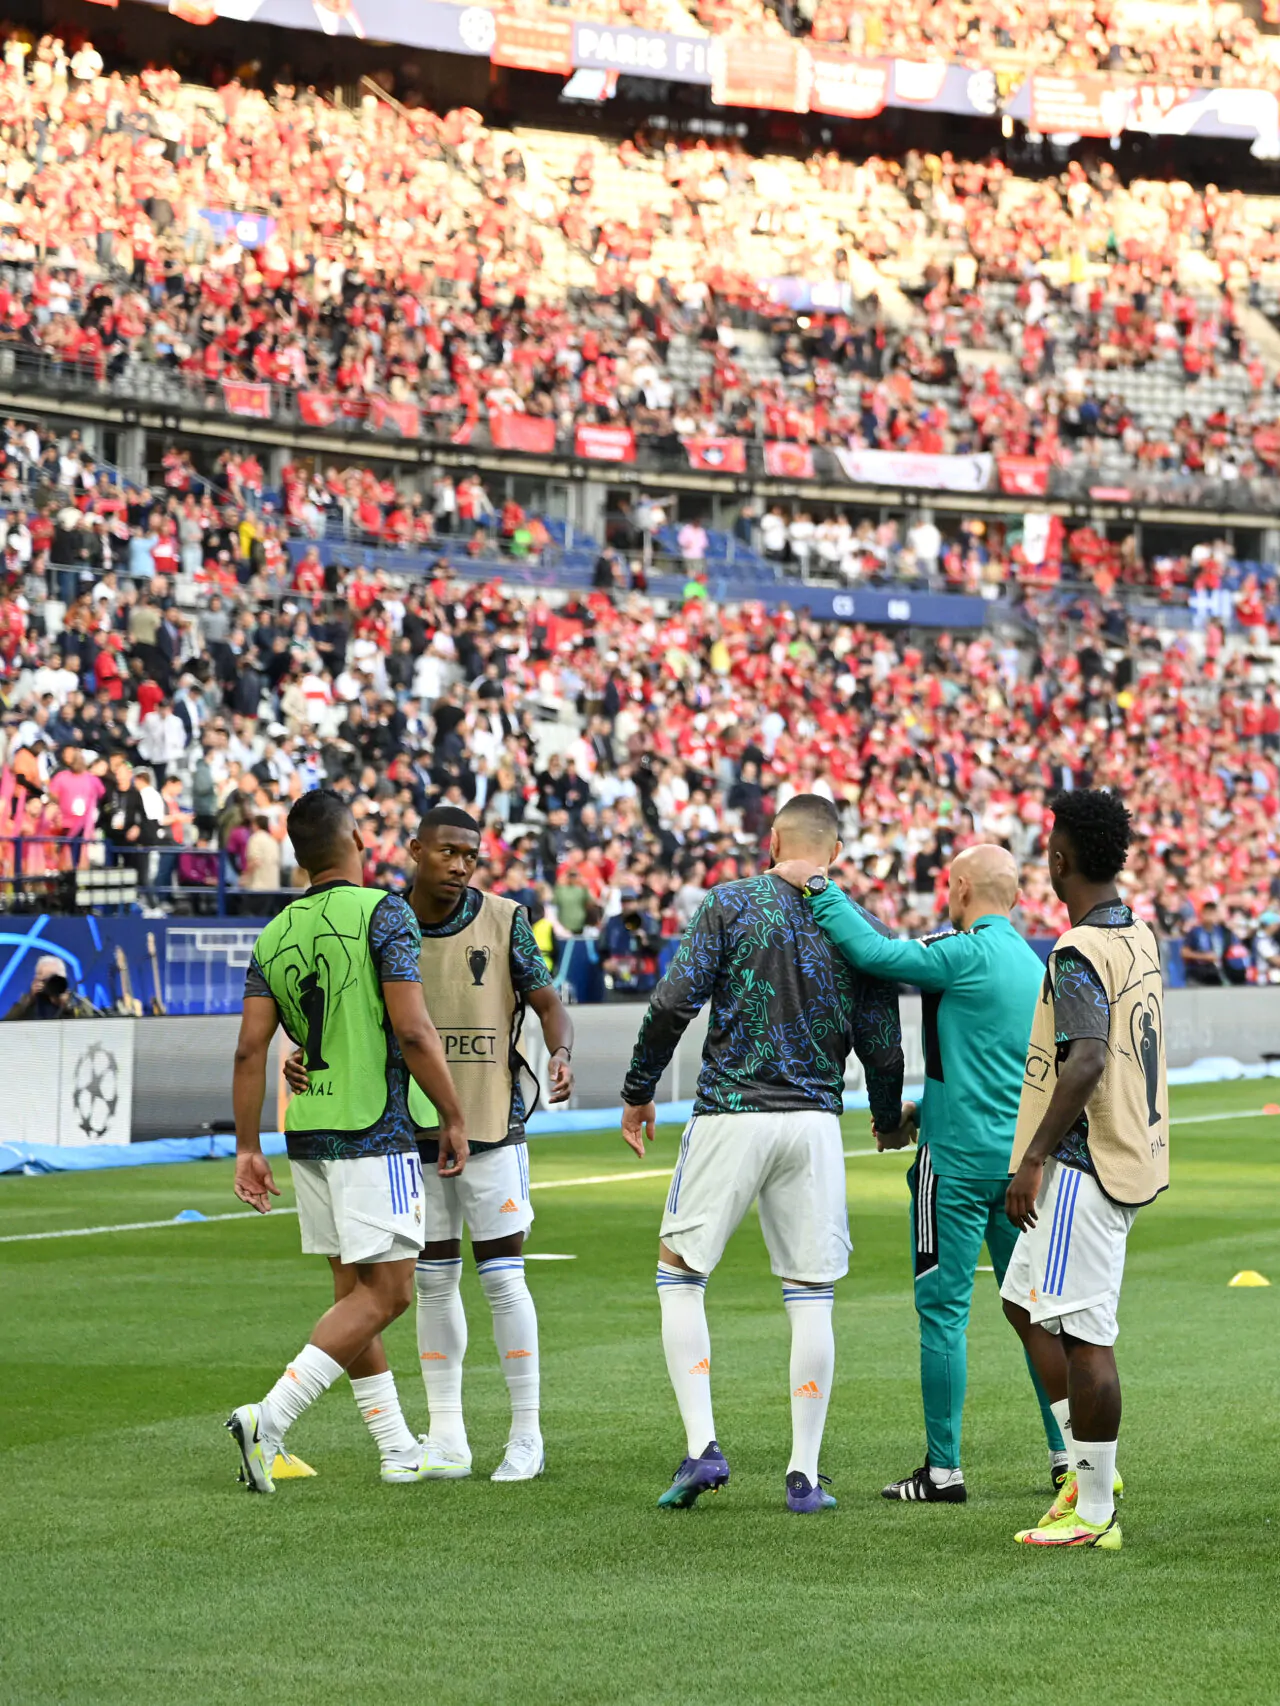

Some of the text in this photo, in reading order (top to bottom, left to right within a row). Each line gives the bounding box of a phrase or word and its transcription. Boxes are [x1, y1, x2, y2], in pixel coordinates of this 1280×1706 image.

[577, 27, 668, 70] PARIS
[444, 1035, 497, 1056] PECT
[306, 1081, 335, 1098] NAL
